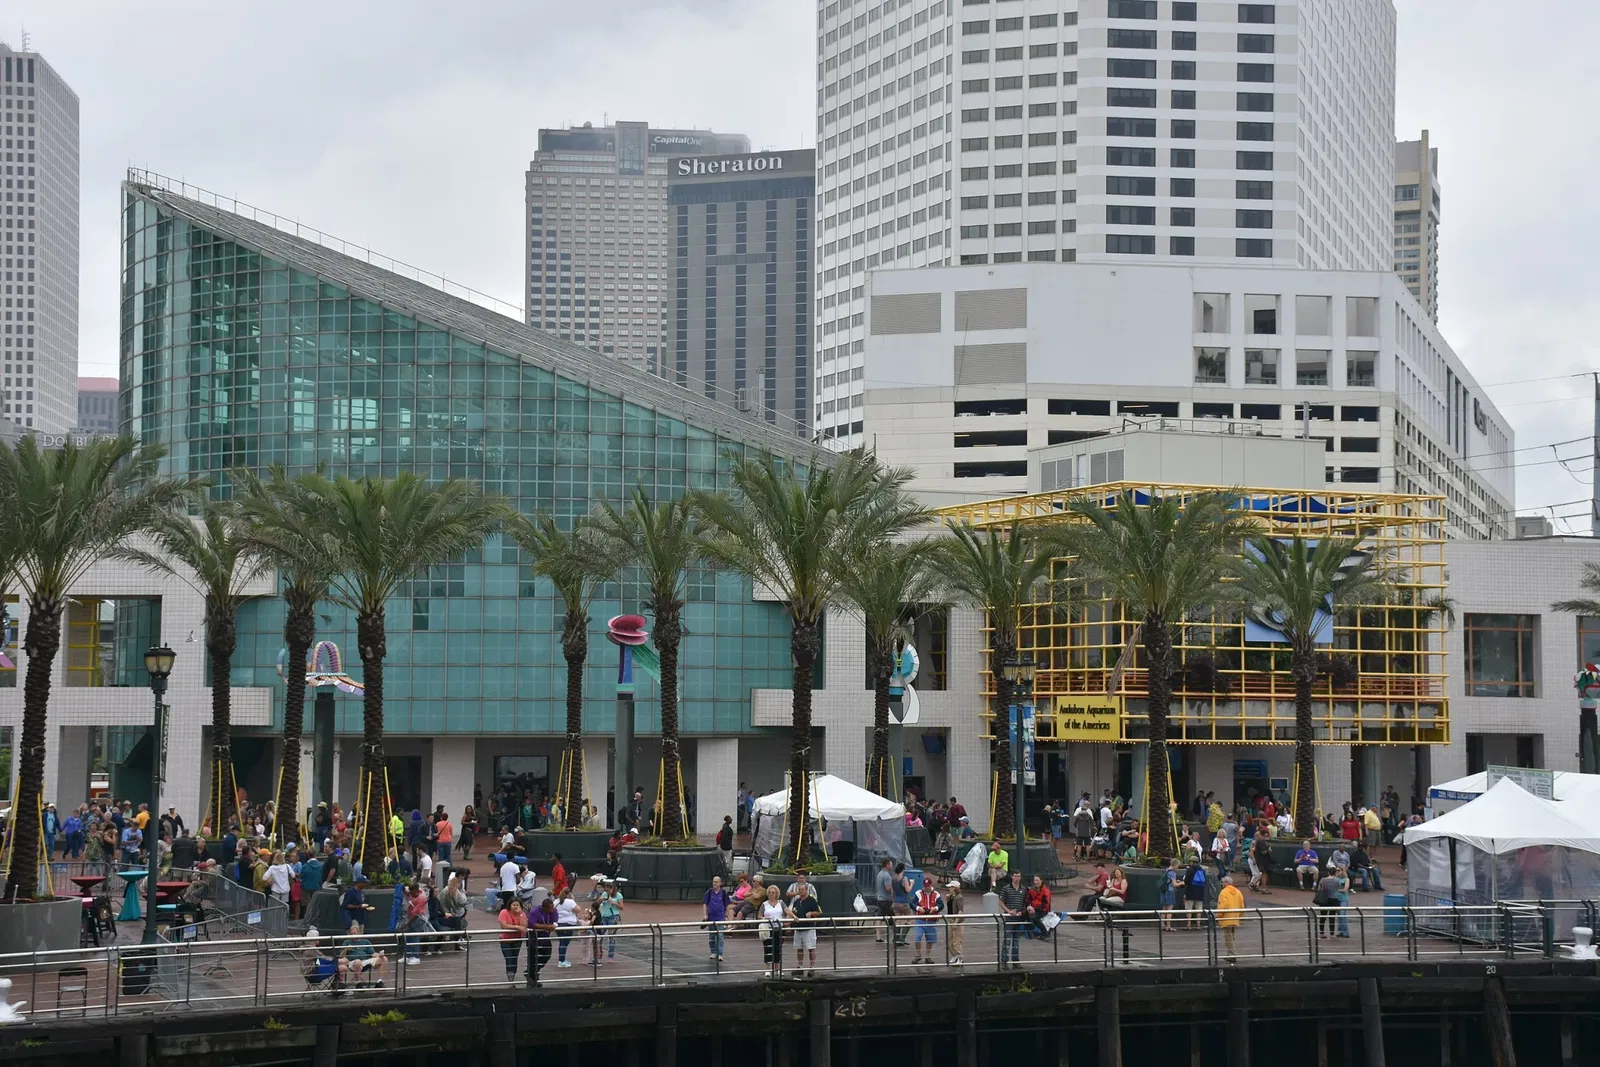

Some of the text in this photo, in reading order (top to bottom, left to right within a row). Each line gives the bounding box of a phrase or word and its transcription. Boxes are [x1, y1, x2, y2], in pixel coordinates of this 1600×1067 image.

[678, 156, 783, 176] Sheraton
[1060, 704, 1116, 717] Audubon Aquarium
[1064, 718, 1110, 729] of the Americas
[1486, 965, 1496, 974] 20
